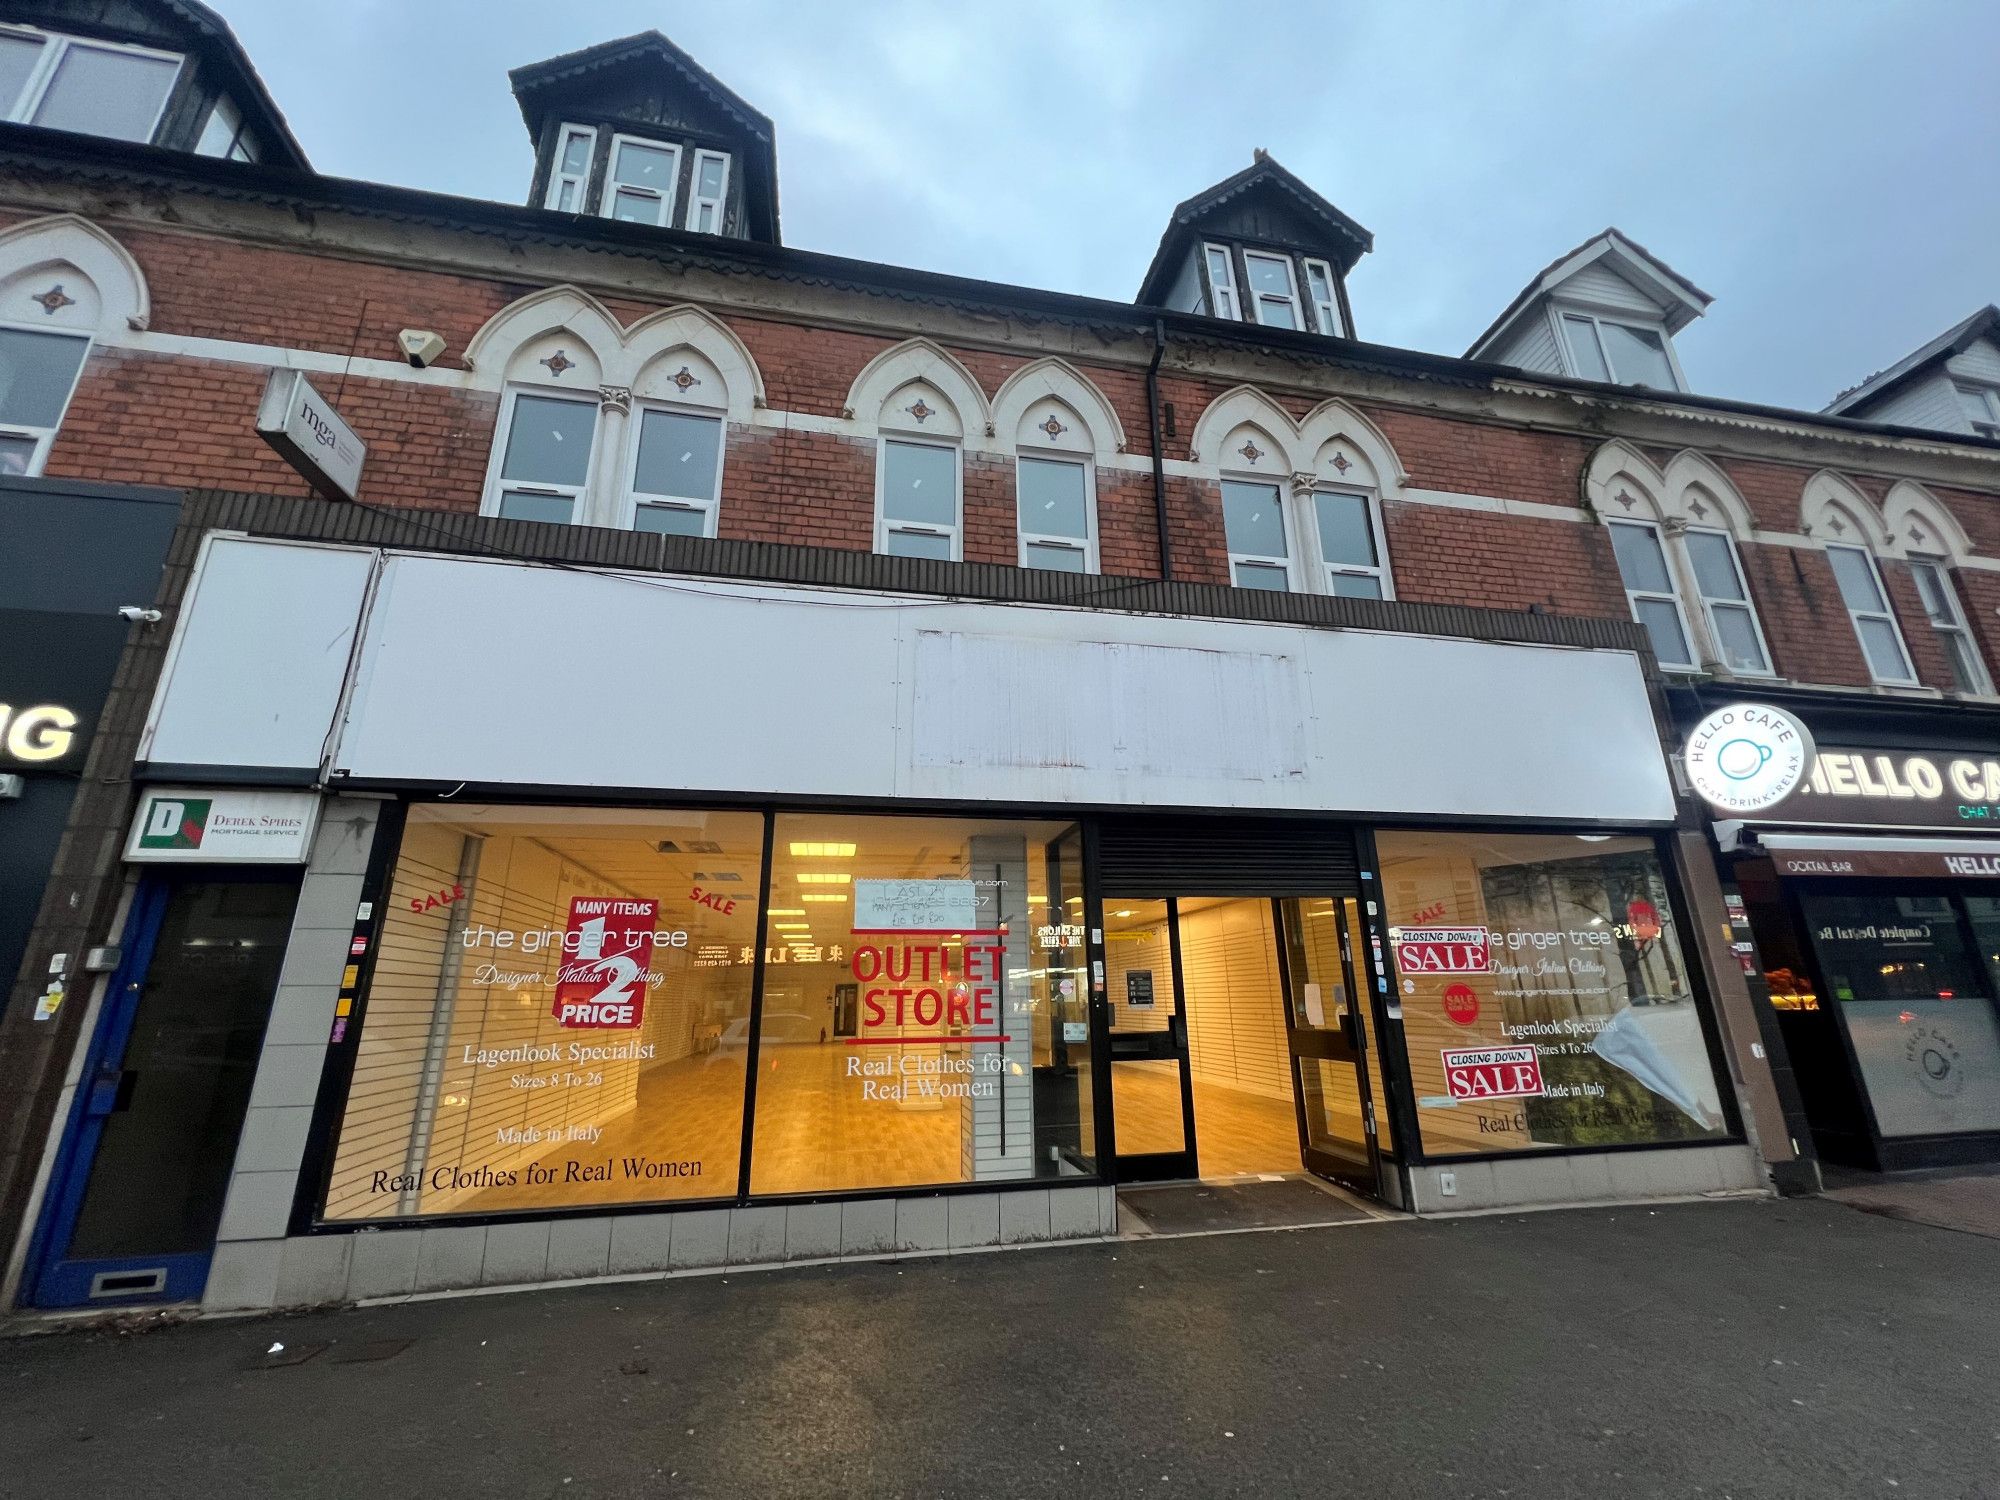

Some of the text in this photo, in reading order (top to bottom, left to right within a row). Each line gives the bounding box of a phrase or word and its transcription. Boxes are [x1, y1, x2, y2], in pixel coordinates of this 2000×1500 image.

[301, 403, 336, 449] mga
[0, 704, 77, 761] G
[1692, 709, 1794, 762] HELLO CAFE
[1697, 755, 1799, 806] CHAT DRINK RELAX
[213, 814, 303, 827] DEREK SPIRES
[1958, 805, 1989, 819] CHAT
[1832, 861, 1854, 873] BAR
[411, 884, 466, 914] SALE
[575, 900, 652, 916] MANY ITEMS
[689, 887, 737, 916] SALE
[1413, 902, 1446, 924] SALE
[461, 925, 688, 953] the ginger tree
[1402, 932, 1443, 941] CLOSING
[1508, 927, 1565, 950] ginger
[1569, 928, 1611, 946] tree
[851, 946, 1007, 983] OUTLET
[1402, 945, 1487, 970] SALE
[1488, 957, 1605, 979] Designer Italian Clothing
[472, 962, 665, 991] Designer Italian Cthing
[863, 988, 994, 1026] STORE
[1446, 995, 1475, 1005] SALE
[561, 1005, 635, 1024] PRICE
[1500, 1016, 1619, 1039] Lagenlook Specialist
[463, 1040, 656, 1068] Lagenlook Specialist
[1450, 1051, 1527, 1066] CLOSING DOWN
[1536, 1042, 1593, 1056] Sizes 8 To 26
[845, 1052, 1010, 1077] Real Clothes for
[511, 1072, 602, 1088] Sizes 8 To 26
[862, 1078, 994, 1101] Real Women
[1452, 1065, 1538, 1097] SALE
[1542, 1081, 1605, 1098] Made in Italy
[496, 1124, 603, 1145] Made in Italy
[1478, 1114, 1510, 1133] Real
[370, 1157, 702, 1193] Real Clothes for Real Women
